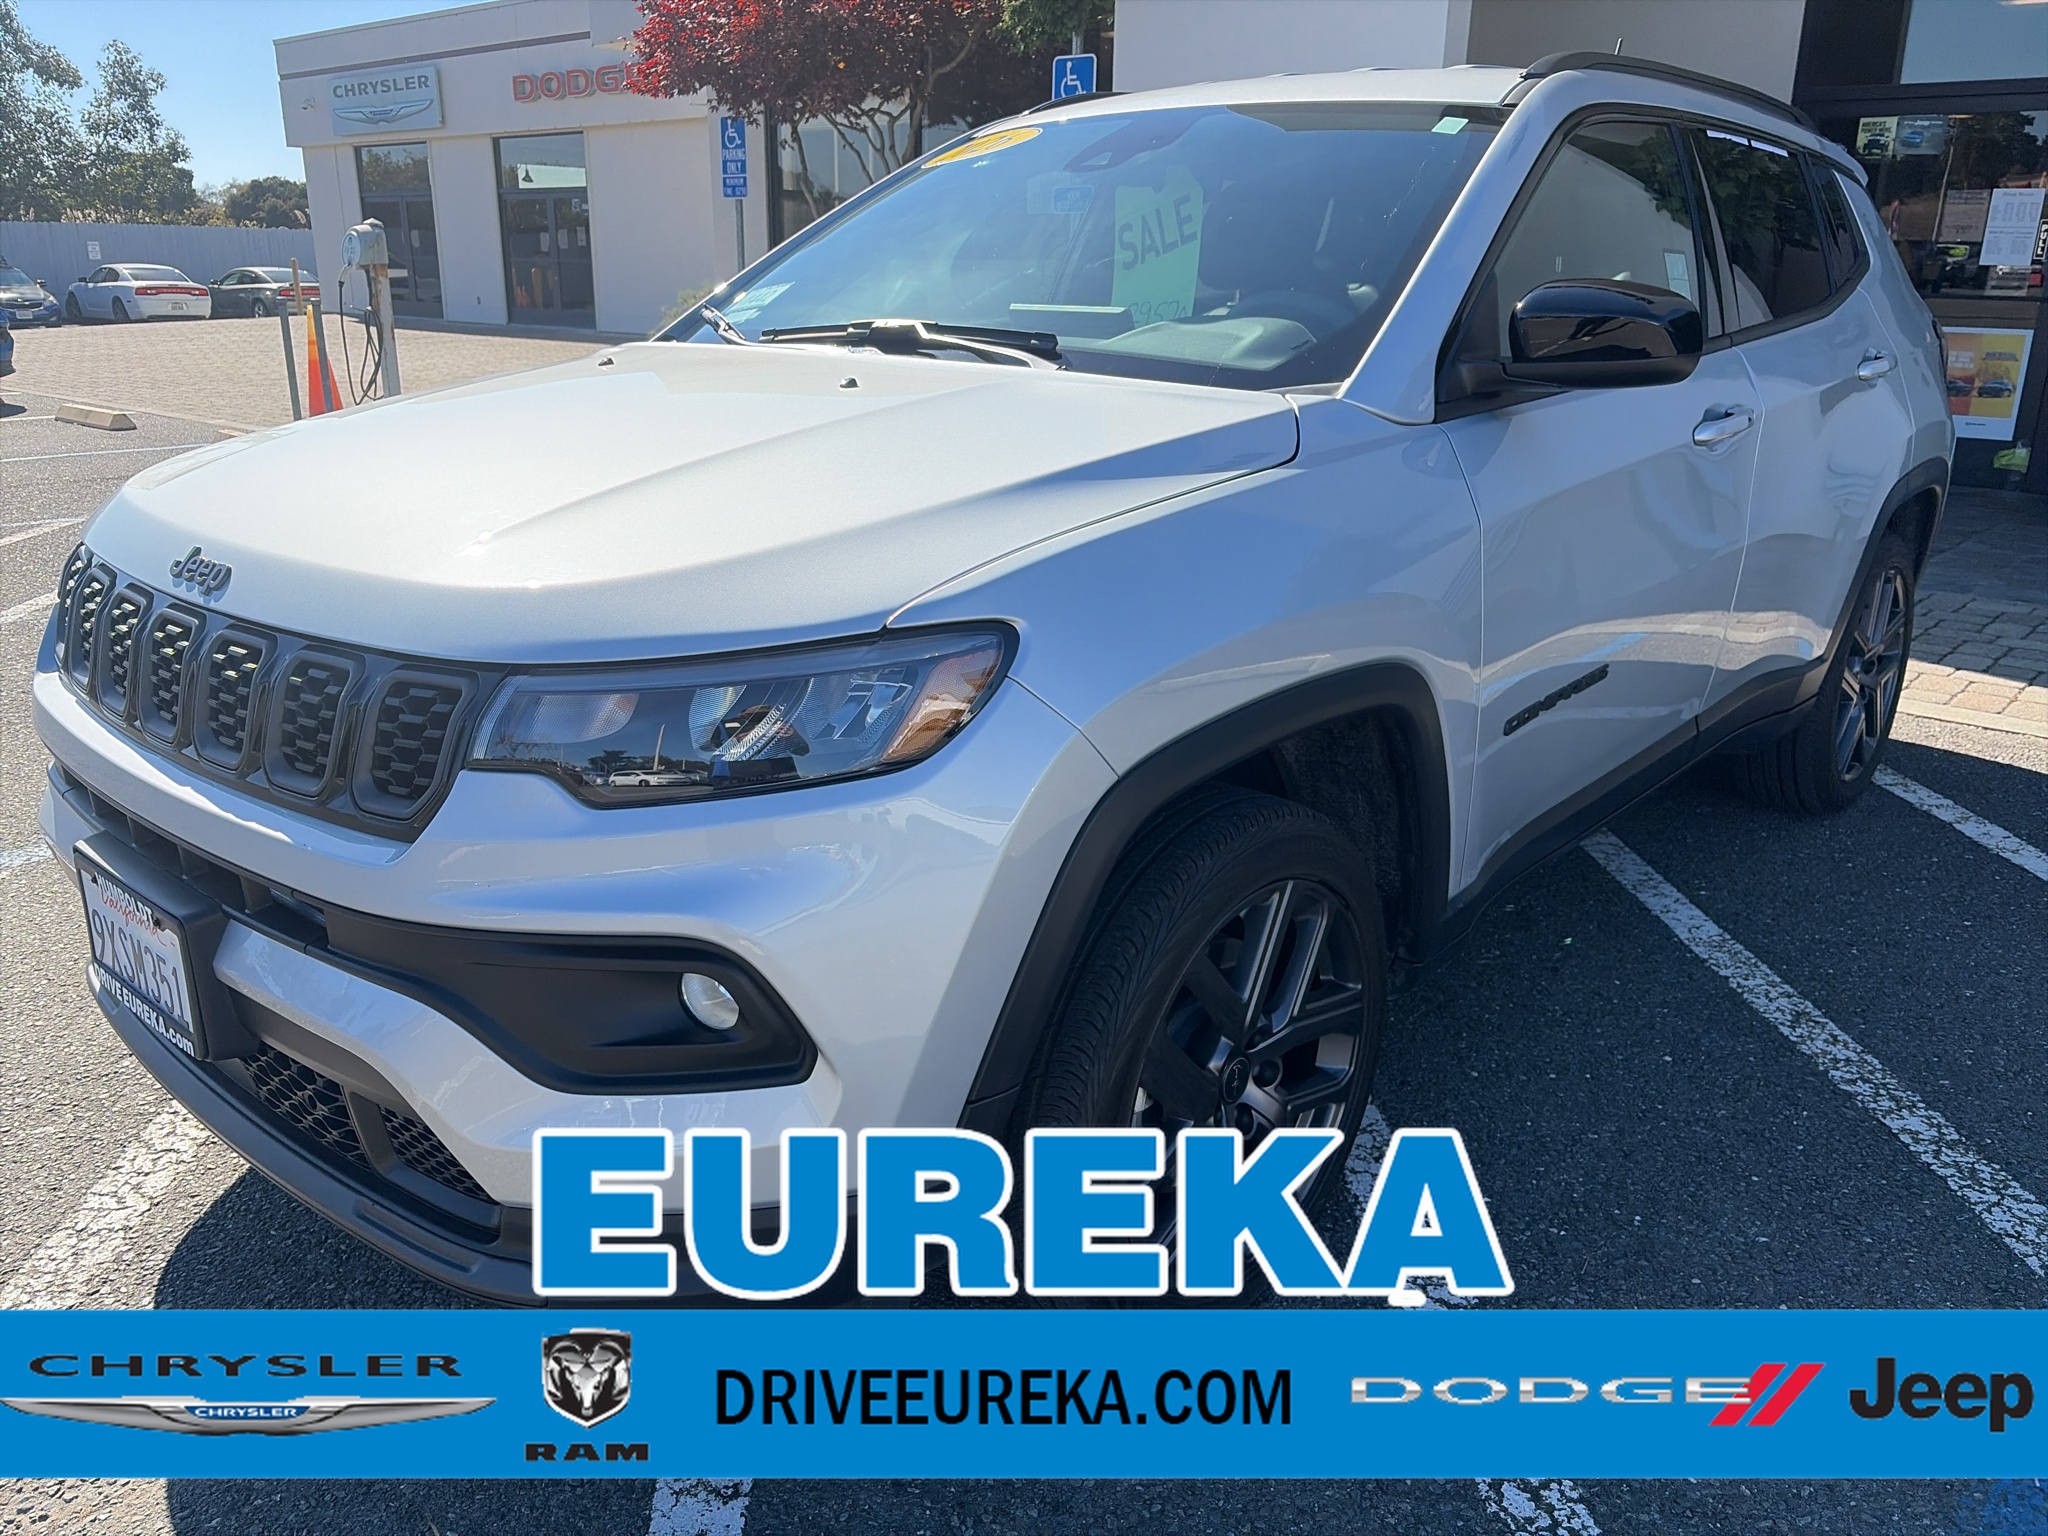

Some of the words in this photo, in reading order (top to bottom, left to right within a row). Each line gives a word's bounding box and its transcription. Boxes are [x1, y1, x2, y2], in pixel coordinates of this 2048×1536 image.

[332, 75, 430, 98] CHRYSLER
[722, 148, 746, 161] PARKING
[726, 161, 742, 174] ONLY
[1117, 193, 1198, 271] SALE
[2036, 224, 2048, 255] PULL
[169, 545, 233, 597] Jeep
[95, 871, 153, 924] HUMBOLDT
[92, 908, 190, 1031] 9XSM351
